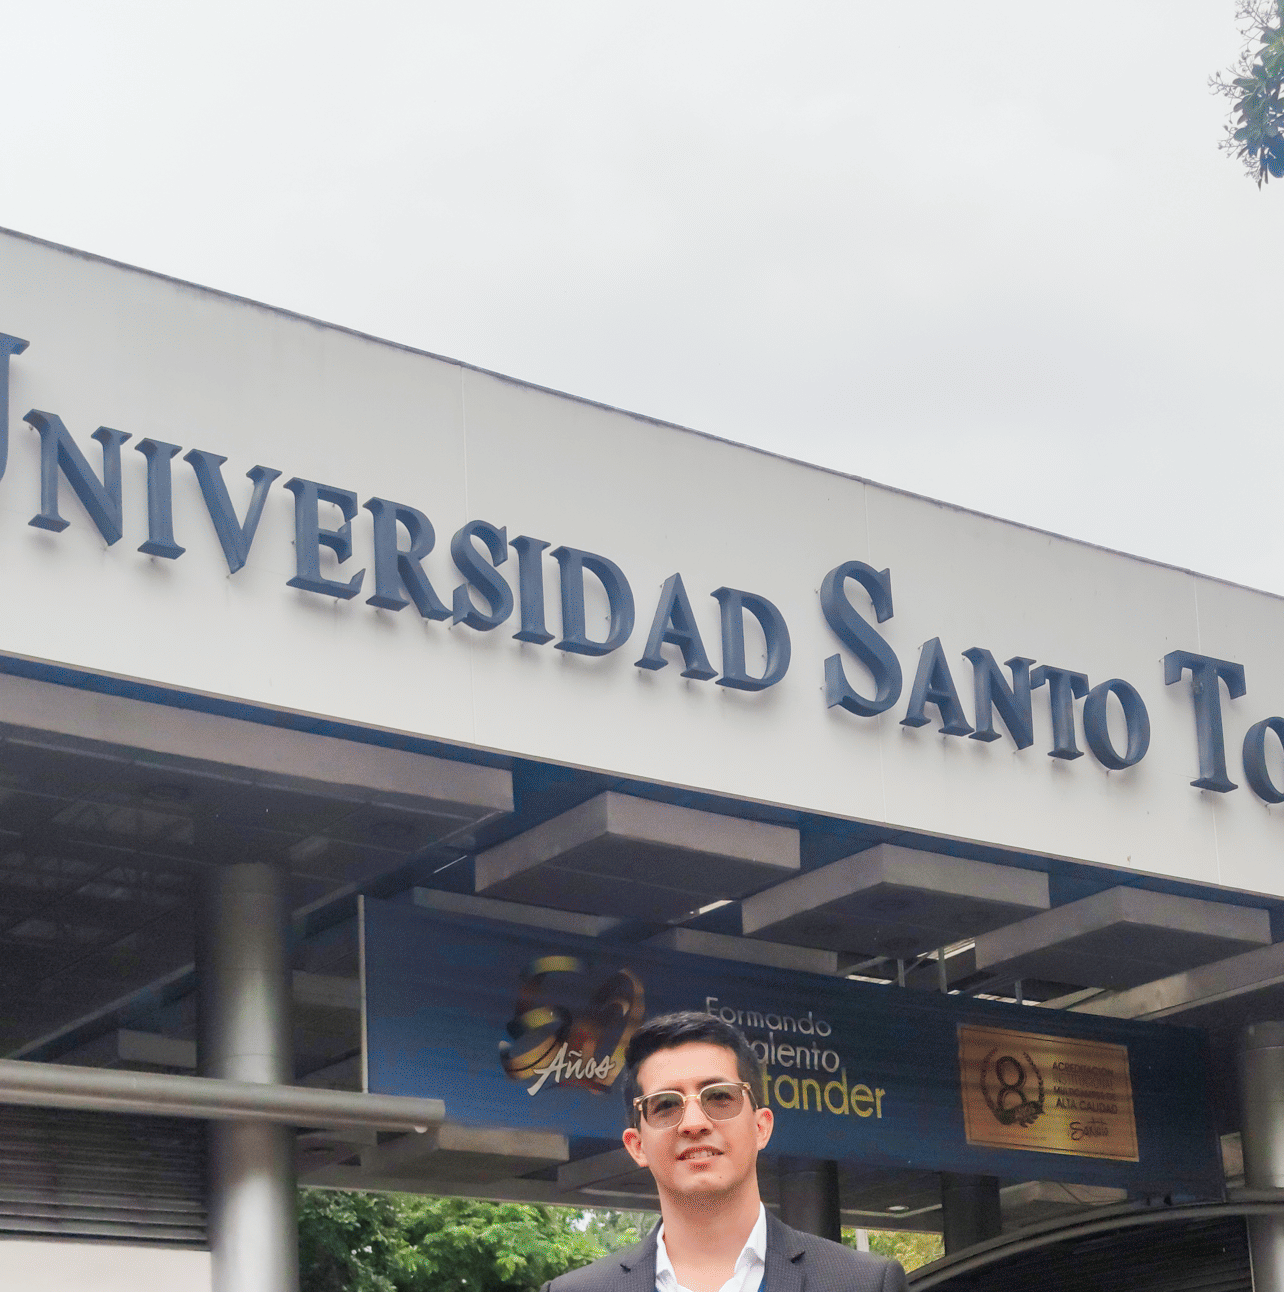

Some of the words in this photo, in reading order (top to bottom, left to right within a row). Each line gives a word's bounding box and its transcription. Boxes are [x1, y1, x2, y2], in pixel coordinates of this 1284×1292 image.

[819, 559, 1151, 771] SANTO
[705, 996, 832, 1037] Formando
[526, 1041, 616, 1097] Años
[750, 1031, 840, 1073] alento
